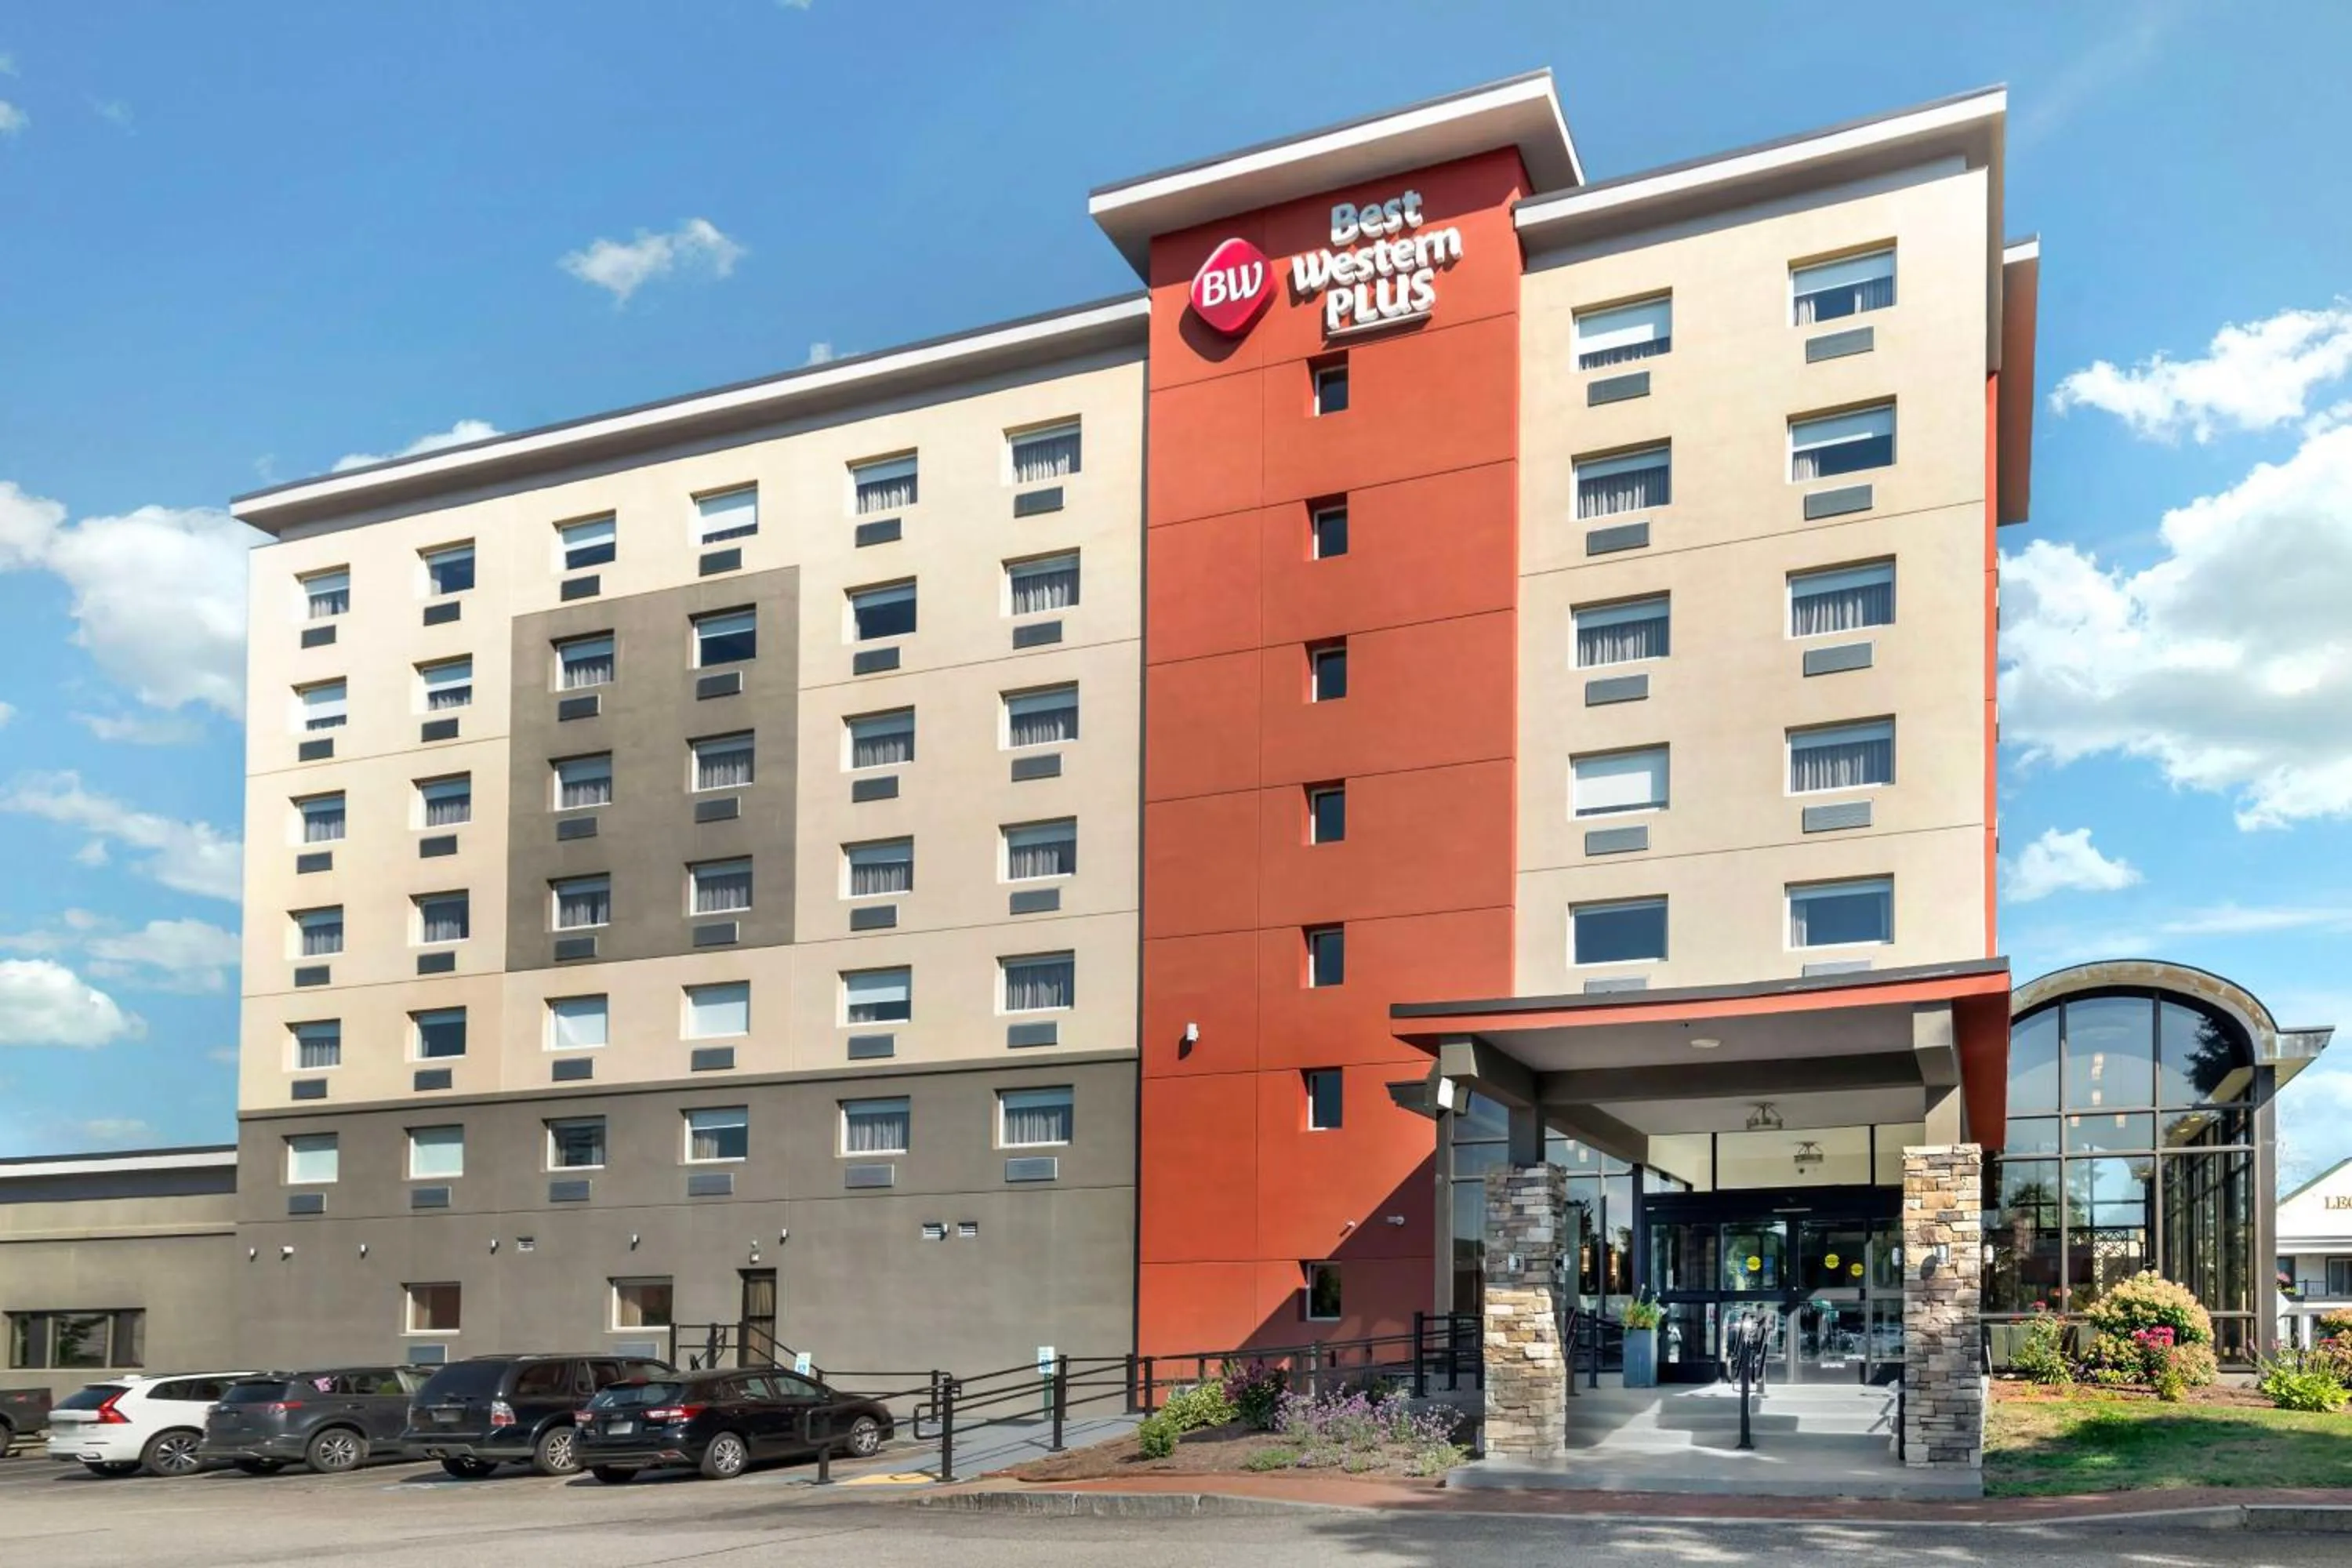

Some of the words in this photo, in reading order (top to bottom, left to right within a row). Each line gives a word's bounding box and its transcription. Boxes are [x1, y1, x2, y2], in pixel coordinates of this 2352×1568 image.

[1330, 190, 1423, 246] Best
[1202, 261, 1263, 307] BW
[1292, 227, 1462, 293] Western
[1327, 267, 1436, 328] PLUS
